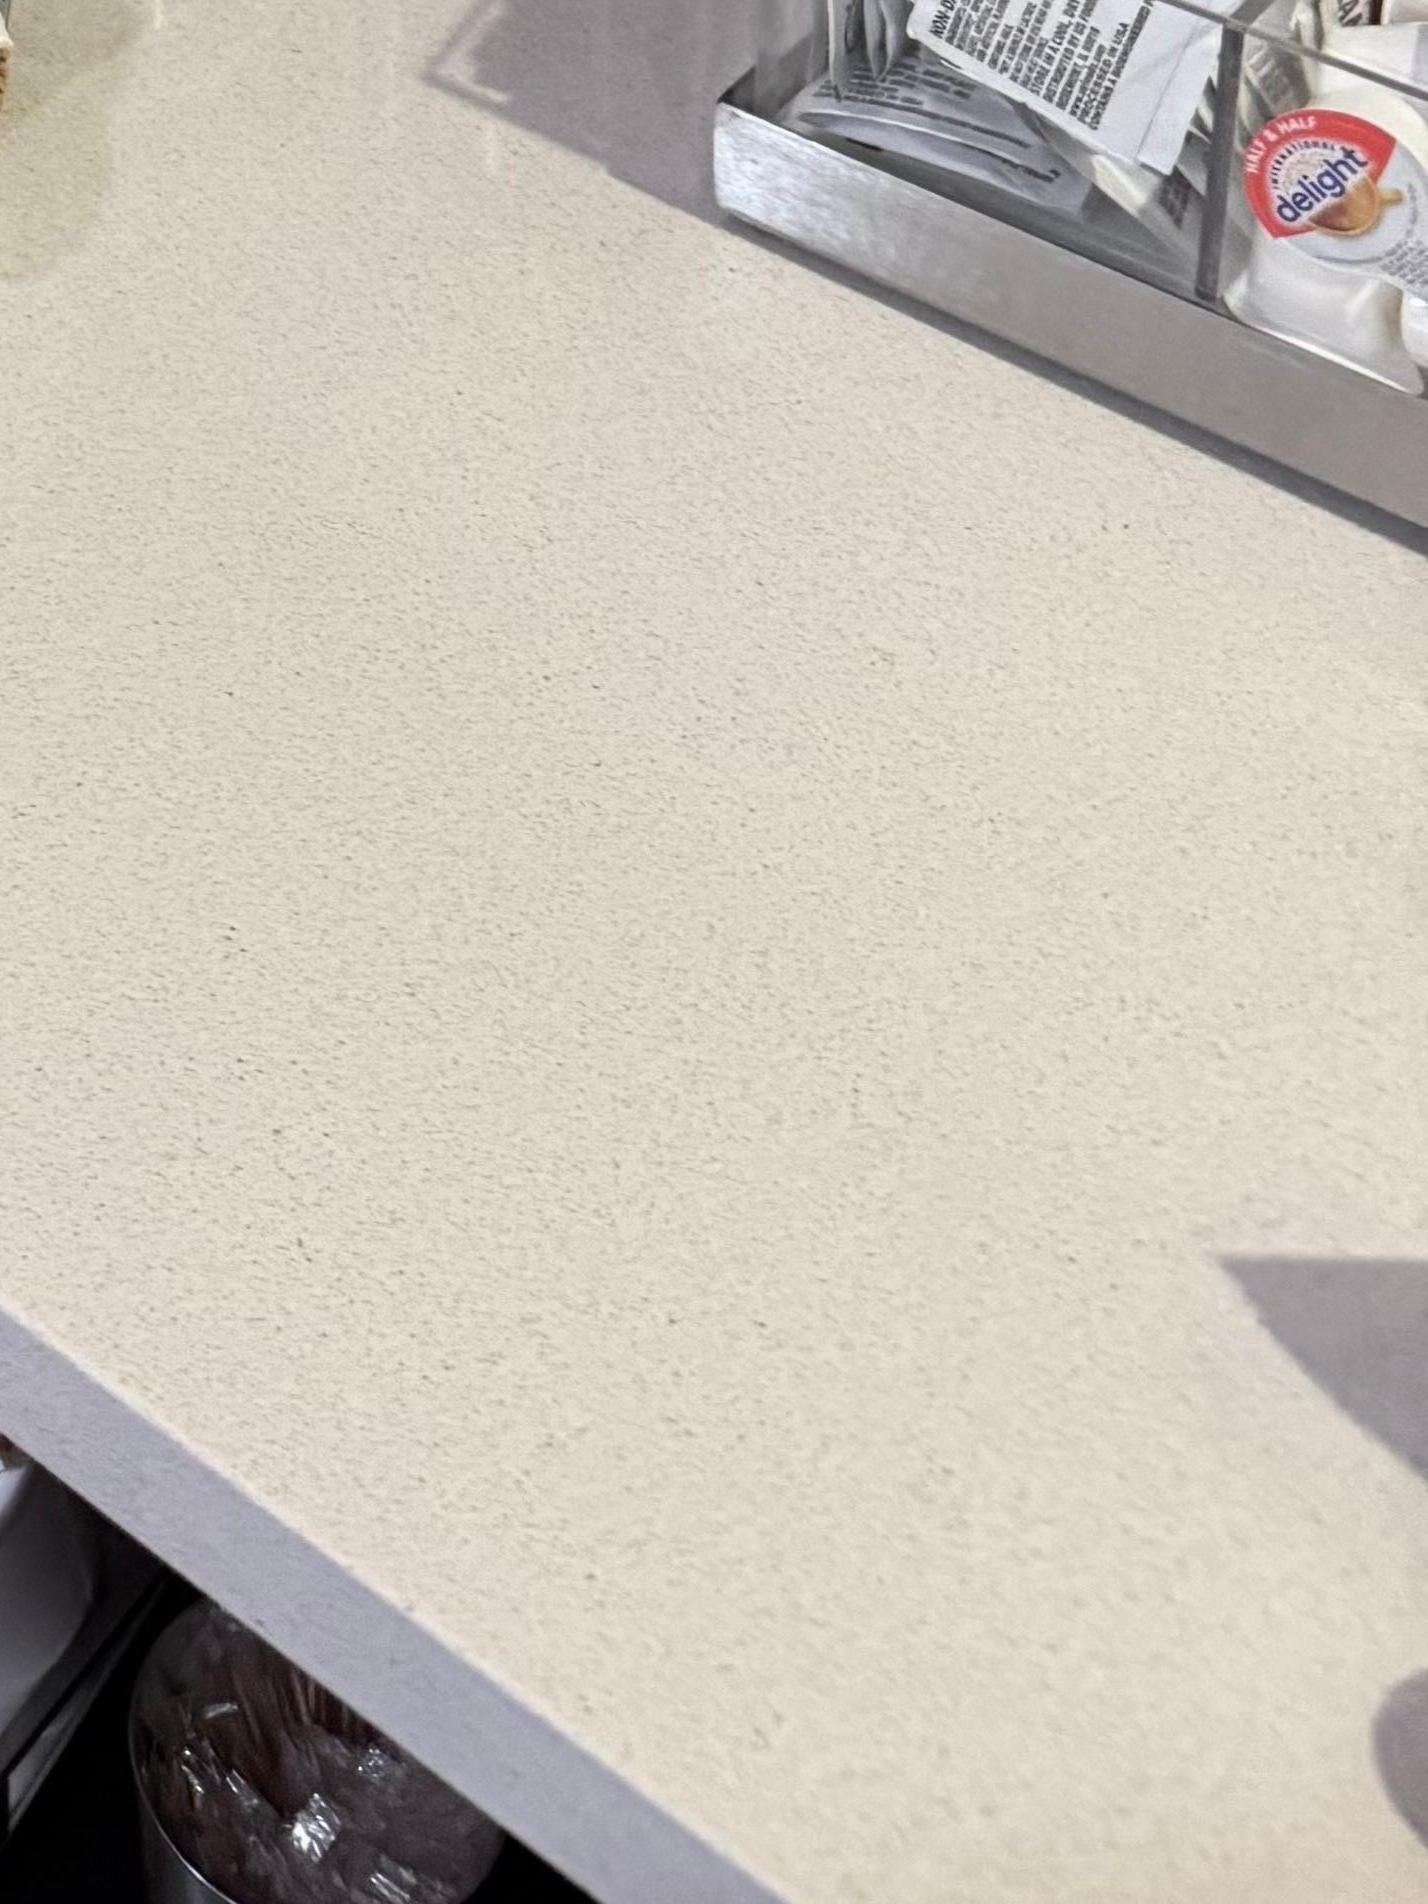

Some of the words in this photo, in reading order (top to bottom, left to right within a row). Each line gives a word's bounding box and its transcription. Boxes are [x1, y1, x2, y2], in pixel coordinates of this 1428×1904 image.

[1111, 20, 1129, 45] USA
[1246, 140, 1267, 173] HALF
[1275, 115, 1317, 135] HALF
[1276, 146, 1369, 223] delight
